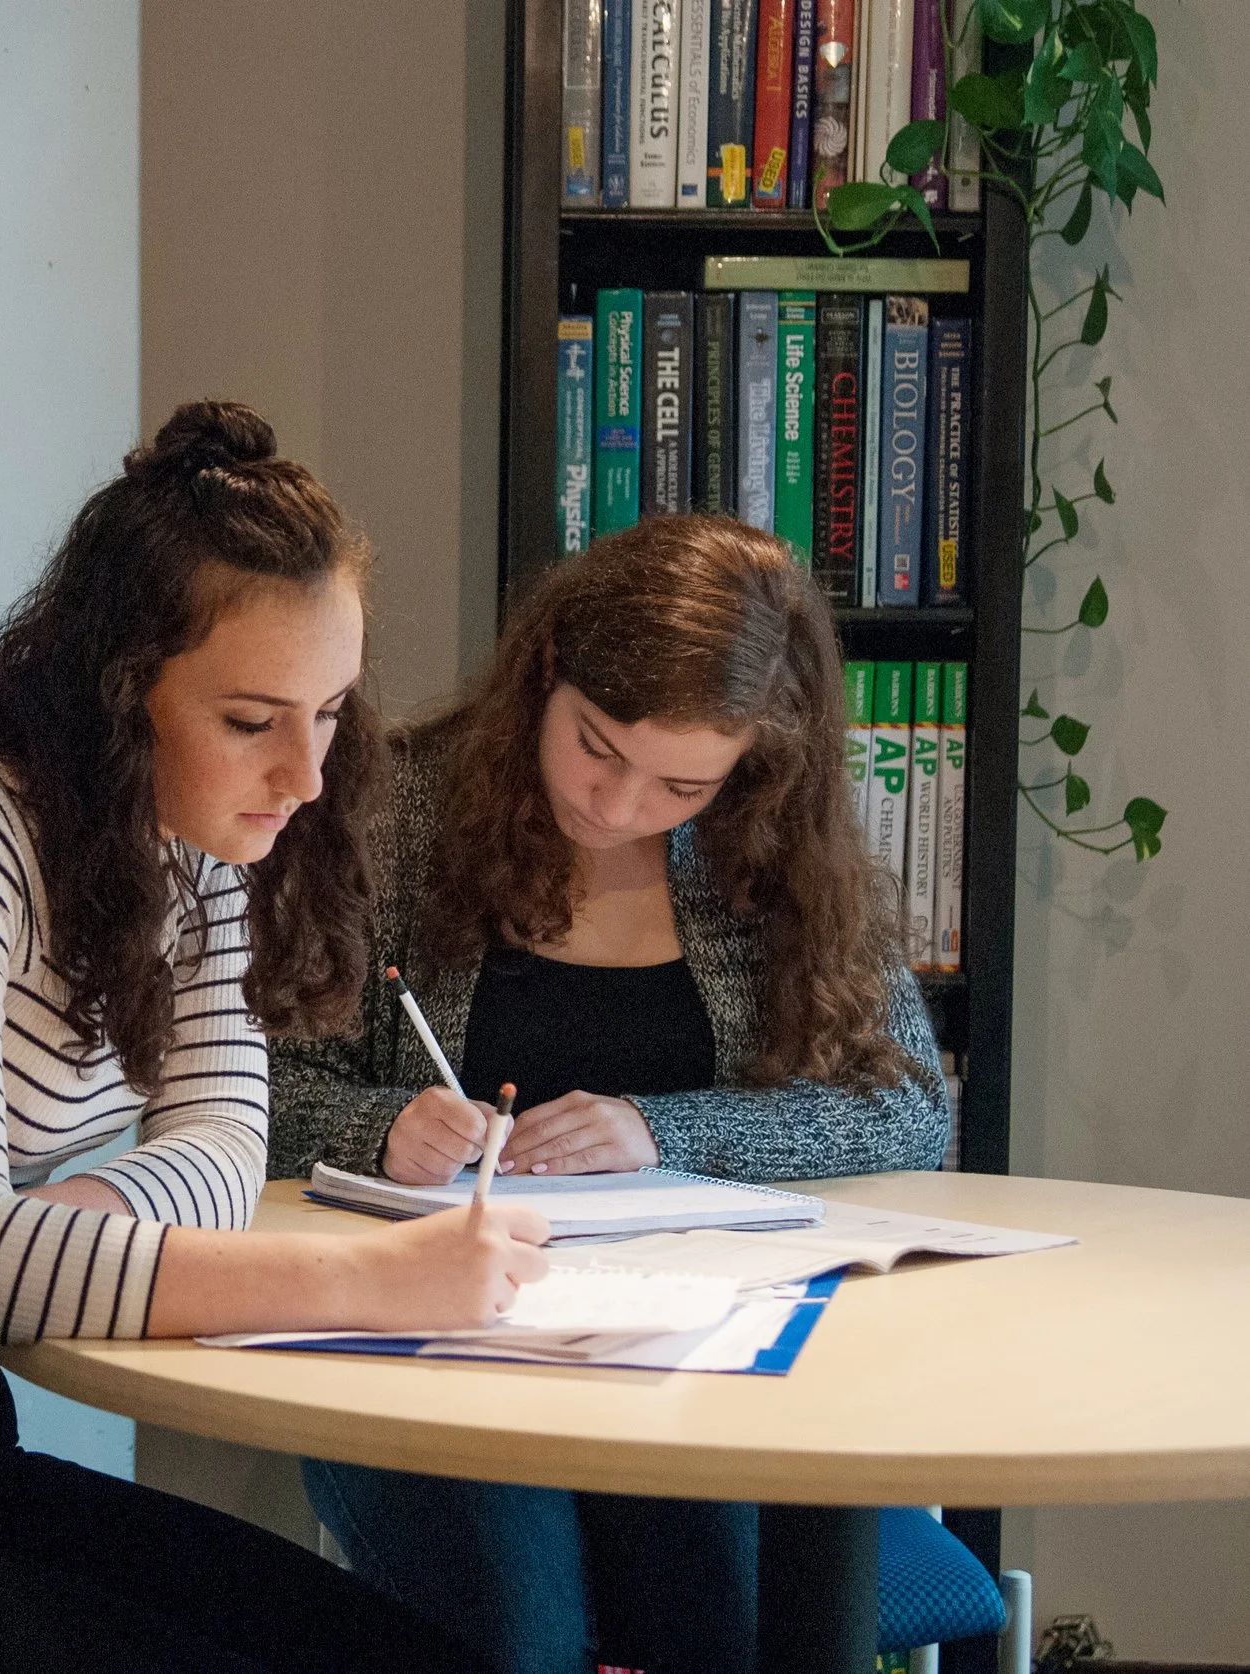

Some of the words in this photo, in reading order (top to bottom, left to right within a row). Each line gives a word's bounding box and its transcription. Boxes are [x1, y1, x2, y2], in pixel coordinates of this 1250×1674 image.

[798, 0, 812, 57] DESIGN
[650, 0, 671, 140] CALCULUS
[795, 64, 809, 119] BASICS
[686, 96, 699, 165] Economics
[762, 150, 784, 189] USED
[606, 311, 619, 364] Concepts
[617, 311, 633, 365] Physical
[785, 334, 804, 367] Life
[619, 366, 632, 417] Science
[656, 346, 680, 390] THE
[707, 341, 721, 426] PRINCIPLES
[950, 367, 960, 388] THE
[607, 378, 618, 418] Action
[656, 391, 680, 442] CELL
[748, 377, 771, 420] The
[784, 371, 804, 442] Science
[707, 429, 721, 447] OF
[891, 349, 919, 506] BIOLOGY
[949, 392, 961, 459] PRACTICE
[655, 447, 666, 505] APPROACH
[667, 449, 678, 513] MOLECULAR
[743, 423, 771, 490] Living
[829, 372, 856, 560] CHEMISTRY
[559, 463, 587, 552] Physics
[941, 544, 955, 583] USED
[846, 738, 867, 783] AP
[874, 736, 906, 795] AP
[915, 736, 937, 777] AP
[946, 738, 963, 770] AP
[917, 781, 930, 834] WORLD
[943, 797, 953, 823] AND
[915, 839, 930, 899] HISTORY
[941, 825, 953, 879] POLITICS
[951, 808, 963, 892] GOVERNMENT
